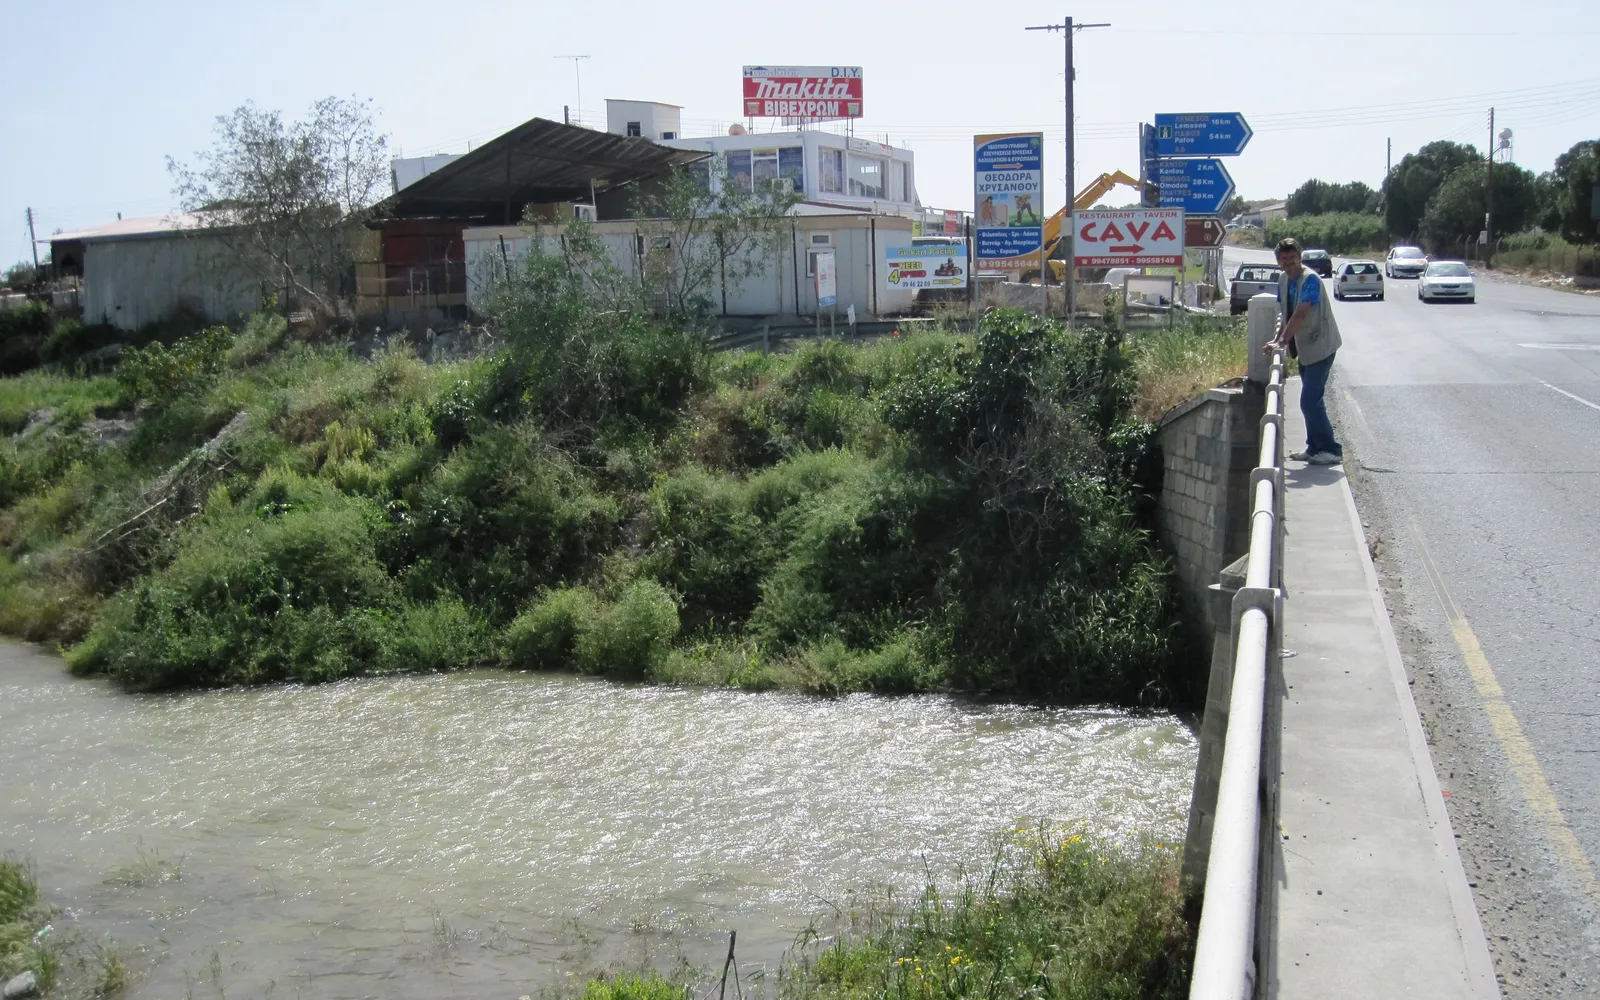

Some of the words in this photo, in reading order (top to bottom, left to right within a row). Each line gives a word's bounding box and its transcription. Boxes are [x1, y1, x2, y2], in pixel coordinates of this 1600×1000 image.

[831, 67, 861, 78] D.I.Y.
[764, 100, 839, 116] ΒΙΒΕΧΡΩΜ
[984, 172, 1032, 182] ΘΕΟΔΩΡΑ
[978, 182, 1038, 192] ΧΡΥΣΑΝΘΟΥ
[1079, 212, 1136, 220] RESTAURANT
[1080, 220, 1177, 242] CAVA
[929, 248, 956, 256] Racing
[888, 269, 900, 284] 4
